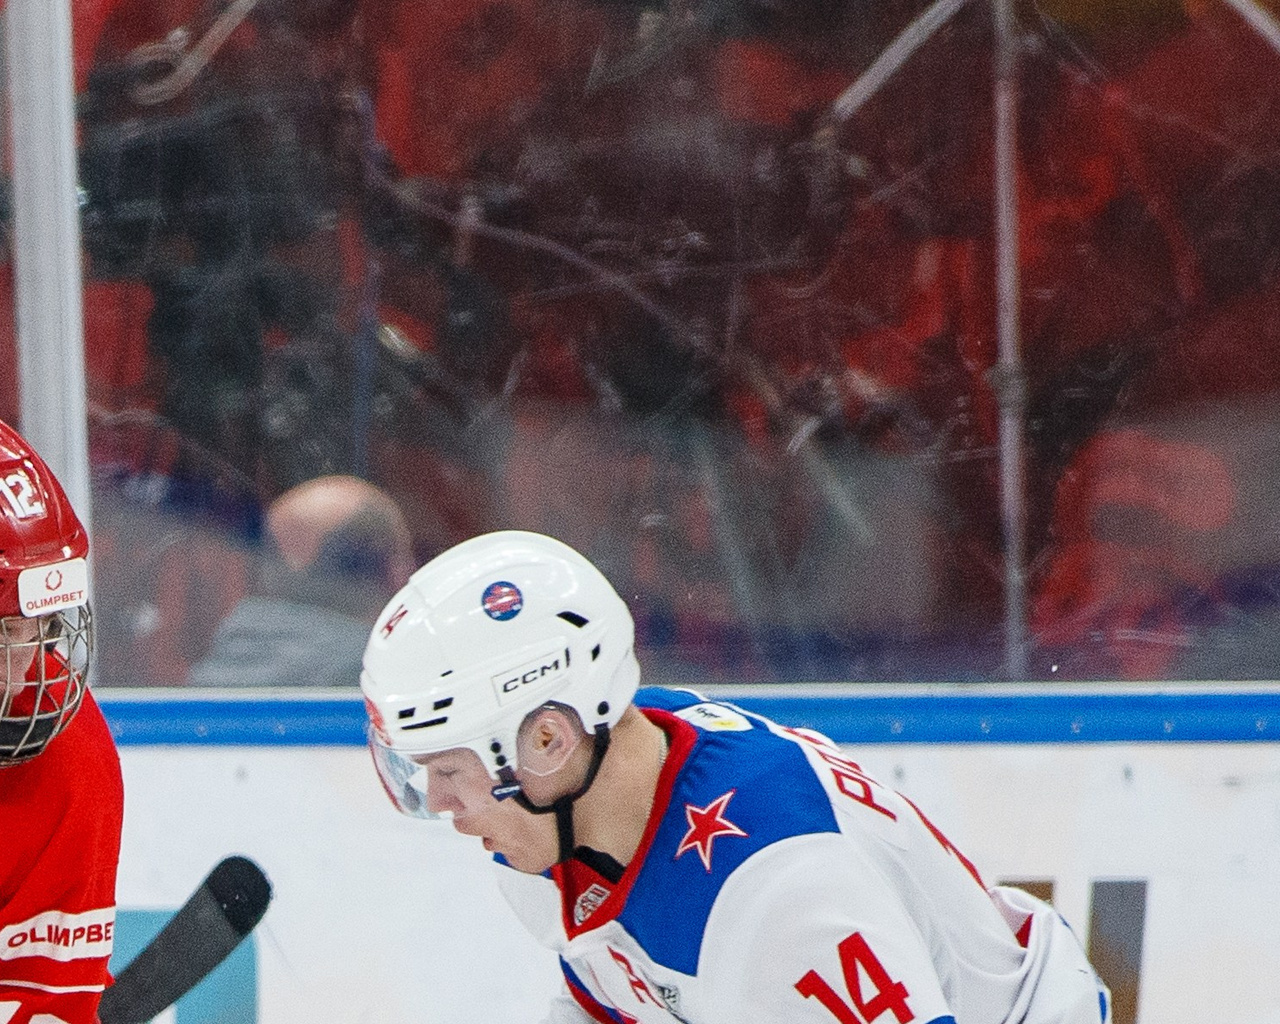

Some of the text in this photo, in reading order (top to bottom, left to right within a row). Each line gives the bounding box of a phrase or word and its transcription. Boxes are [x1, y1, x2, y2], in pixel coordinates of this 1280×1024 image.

[25, 590, 84, 611] OLIMPBET
[503, 659, 560, 693] CCM
[7, 921, 113, 948] OLIMPBE
